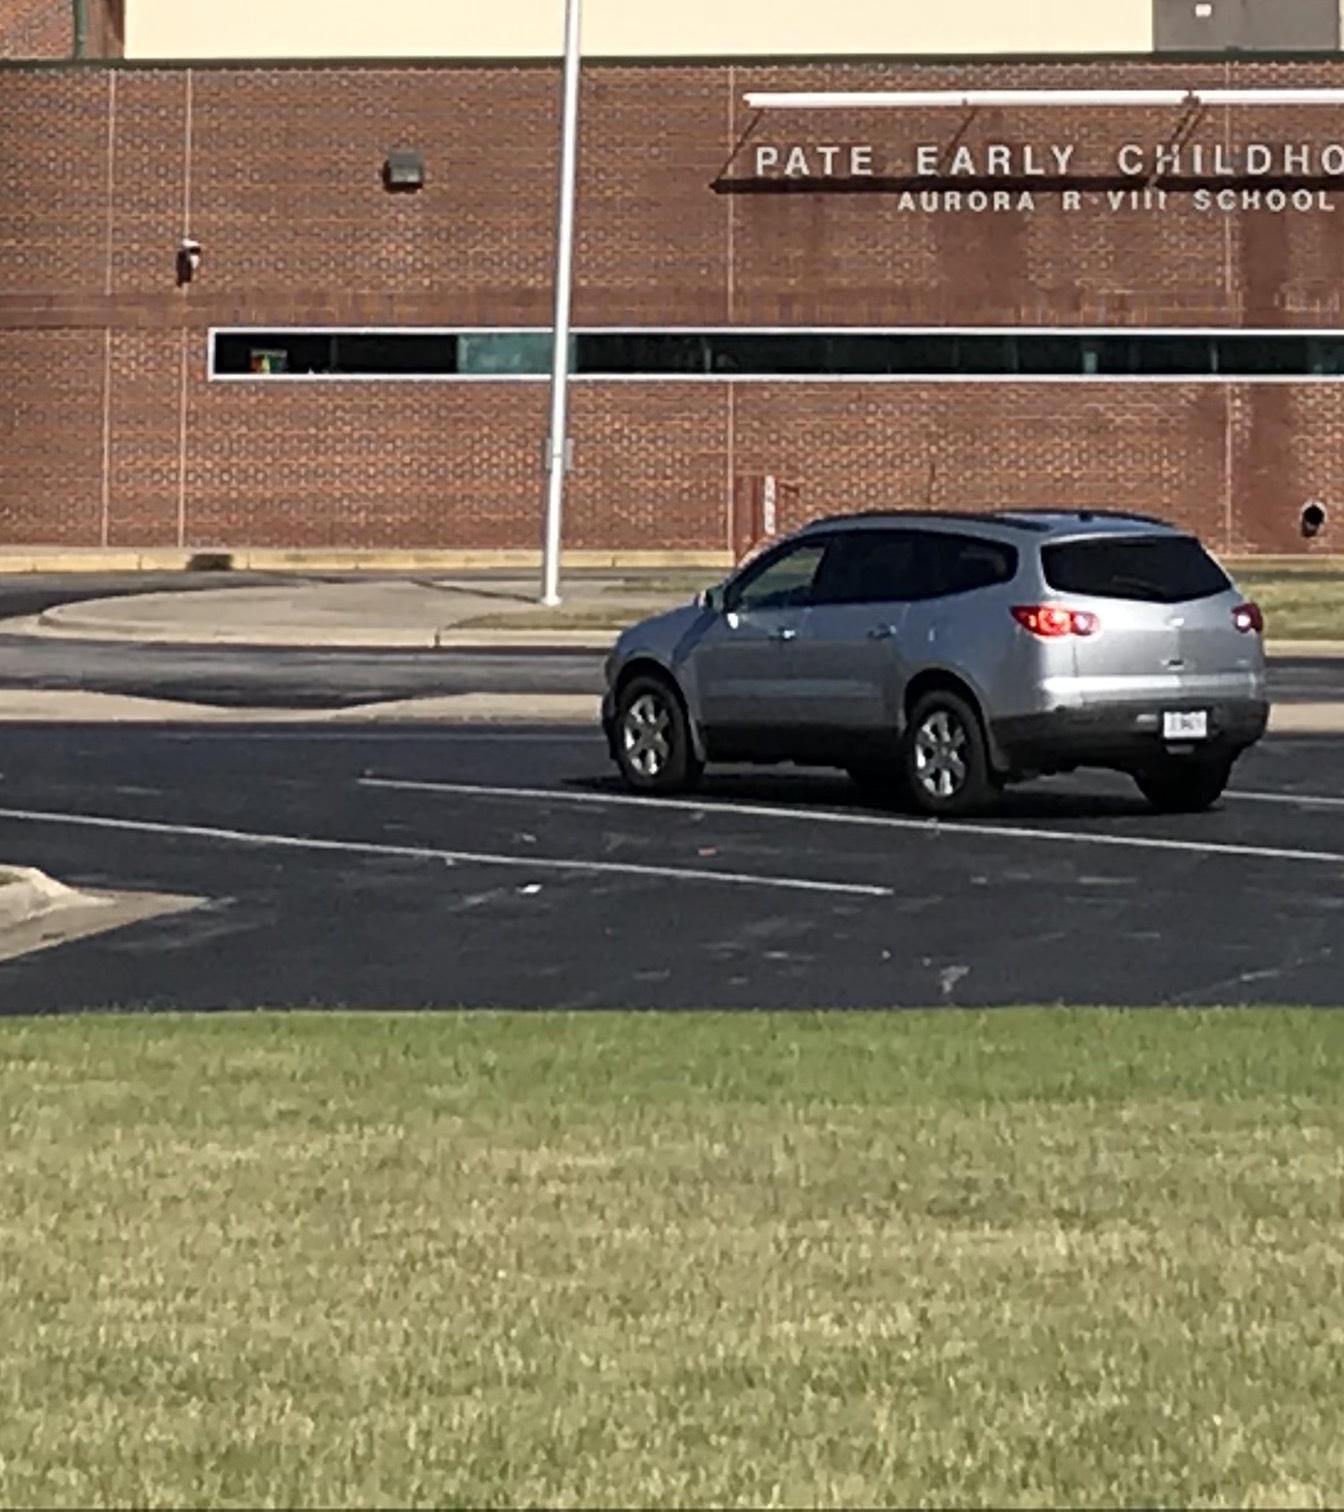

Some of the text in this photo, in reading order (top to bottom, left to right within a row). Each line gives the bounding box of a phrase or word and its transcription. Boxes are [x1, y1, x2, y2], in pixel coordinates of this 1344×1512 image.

[756, 145, 874, 176] PATE
[916, 144, 1075, 176] EARLY
[897, 190, 1035, 212] AURORA
[1192, 189, 1336, 212] SCHOOL
